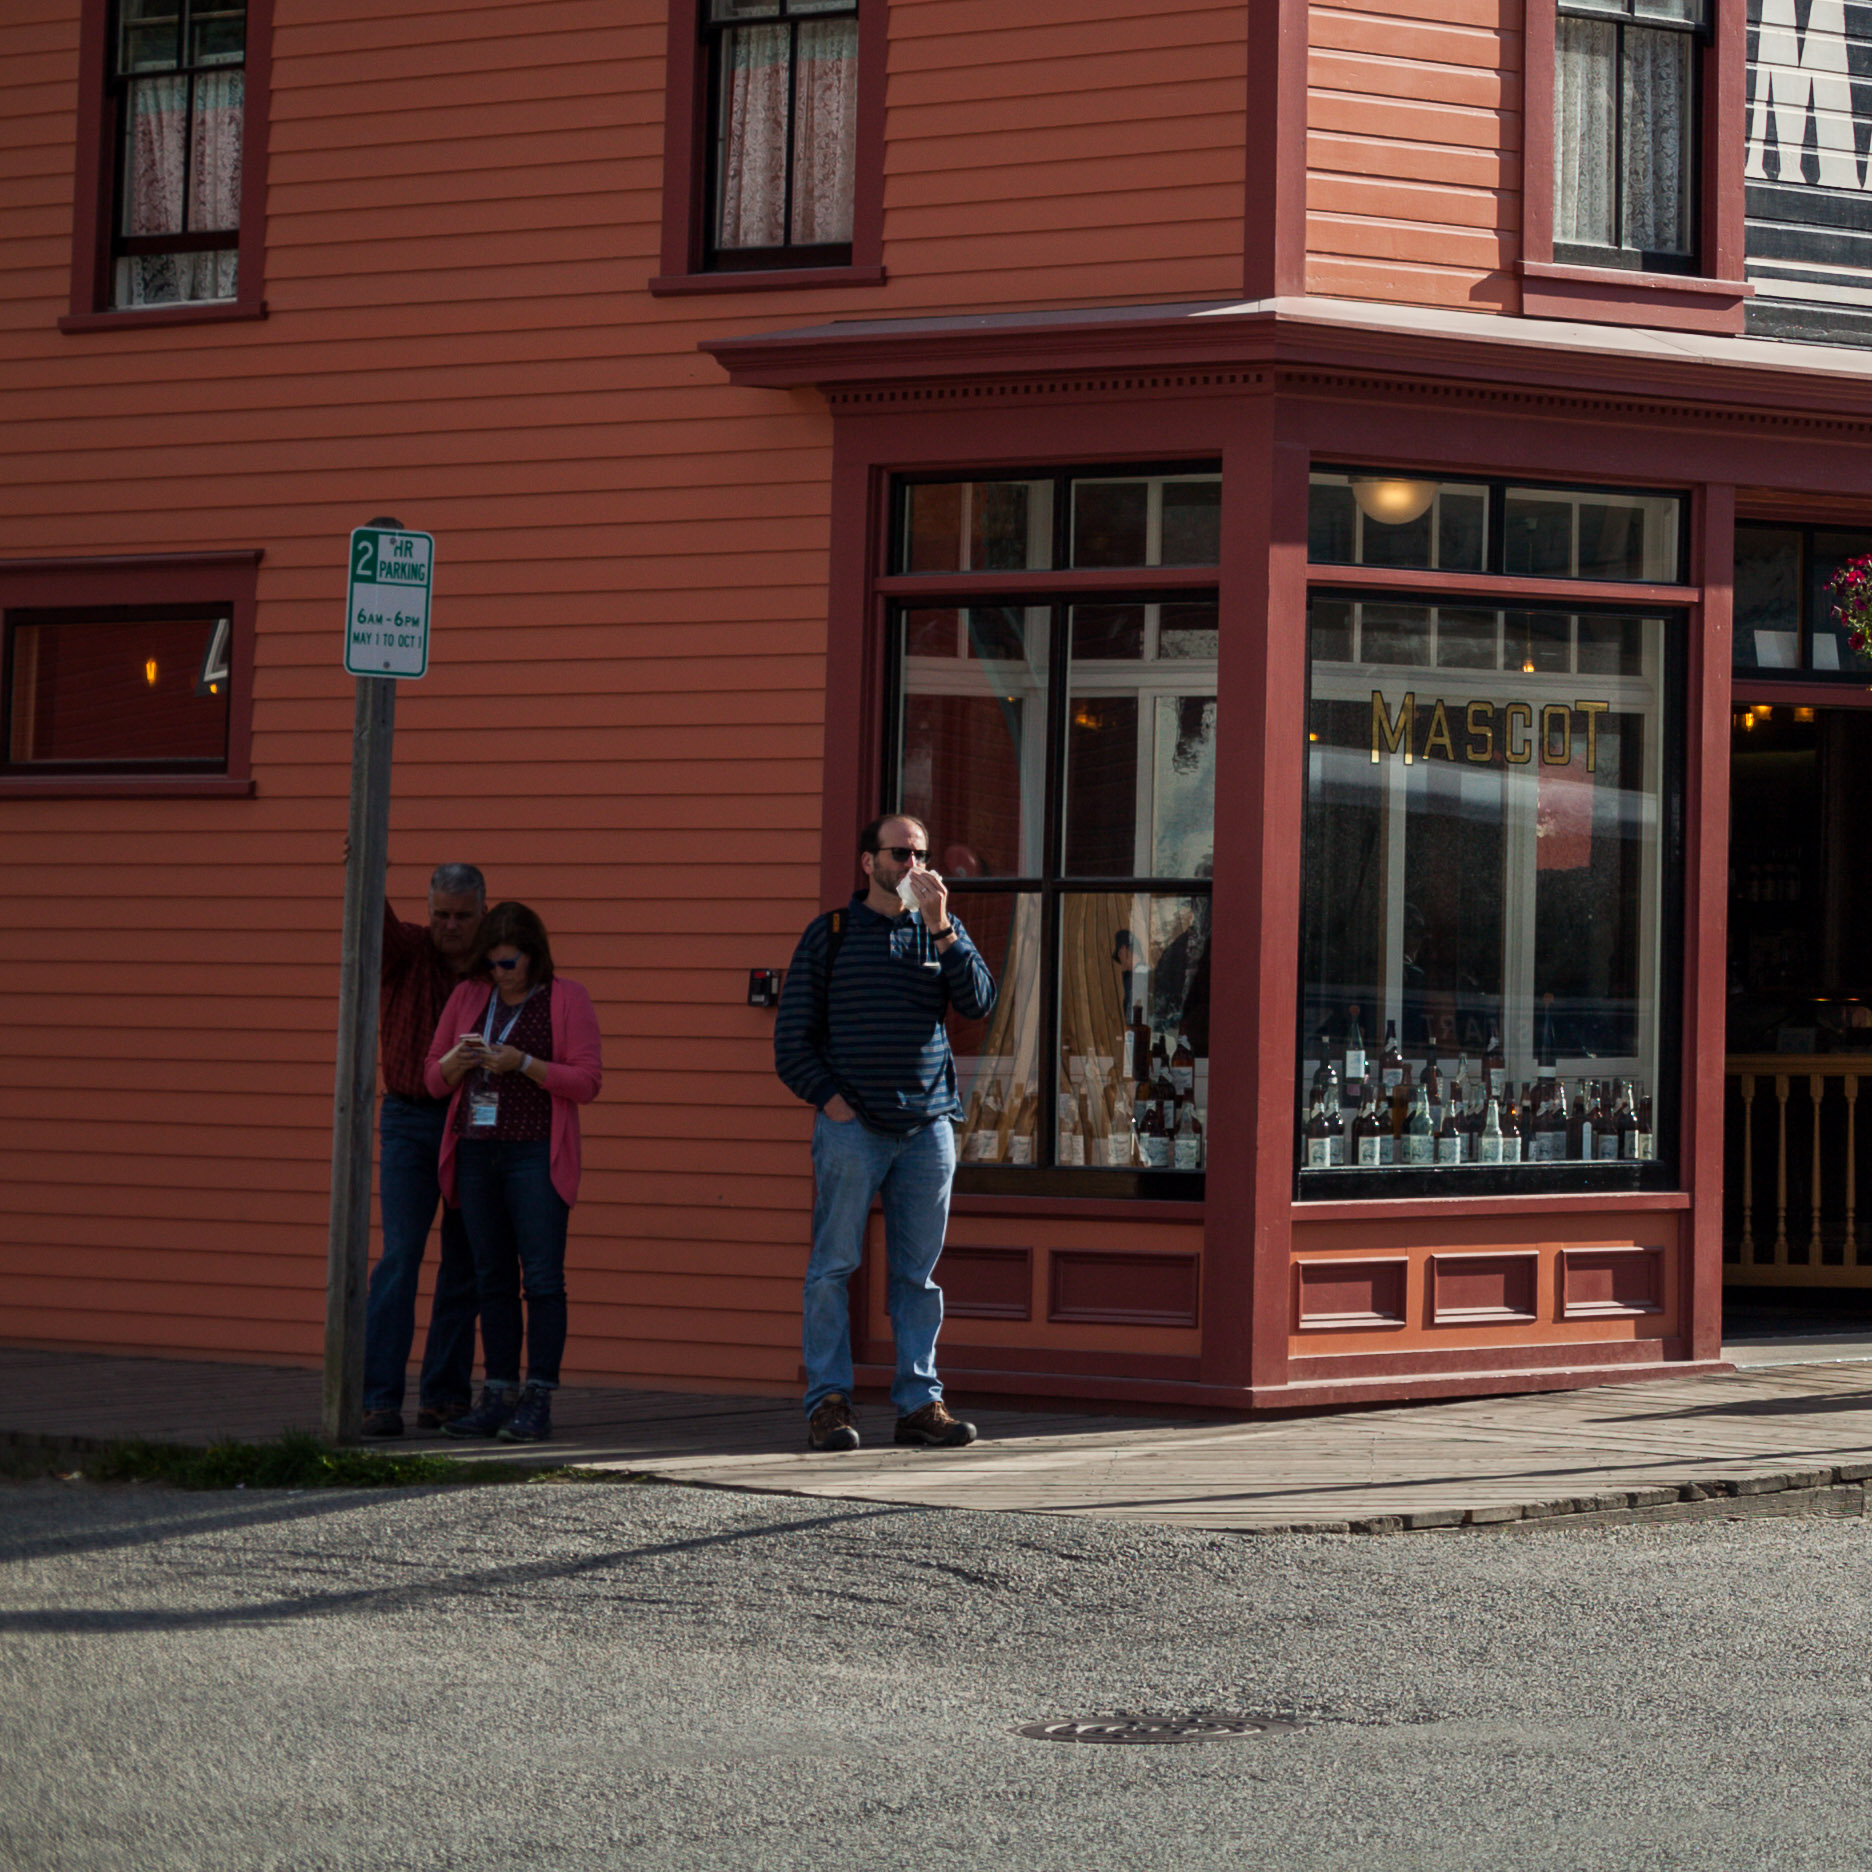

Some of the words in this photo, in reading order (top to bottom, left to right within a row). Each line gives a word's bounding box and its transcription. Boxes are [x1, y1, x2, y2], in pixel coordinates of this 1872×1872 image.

[356, 540, 374, 575] 2
[393, 540, 414, 558] HR
[379, 560, 425, 581] PARKING
[352, 632, 371, 645] MAY
[383, 633, 394, 647] TO
[398, 634, 415, 648] OCT
[1370, 689, 1609, 773] MASCOT
